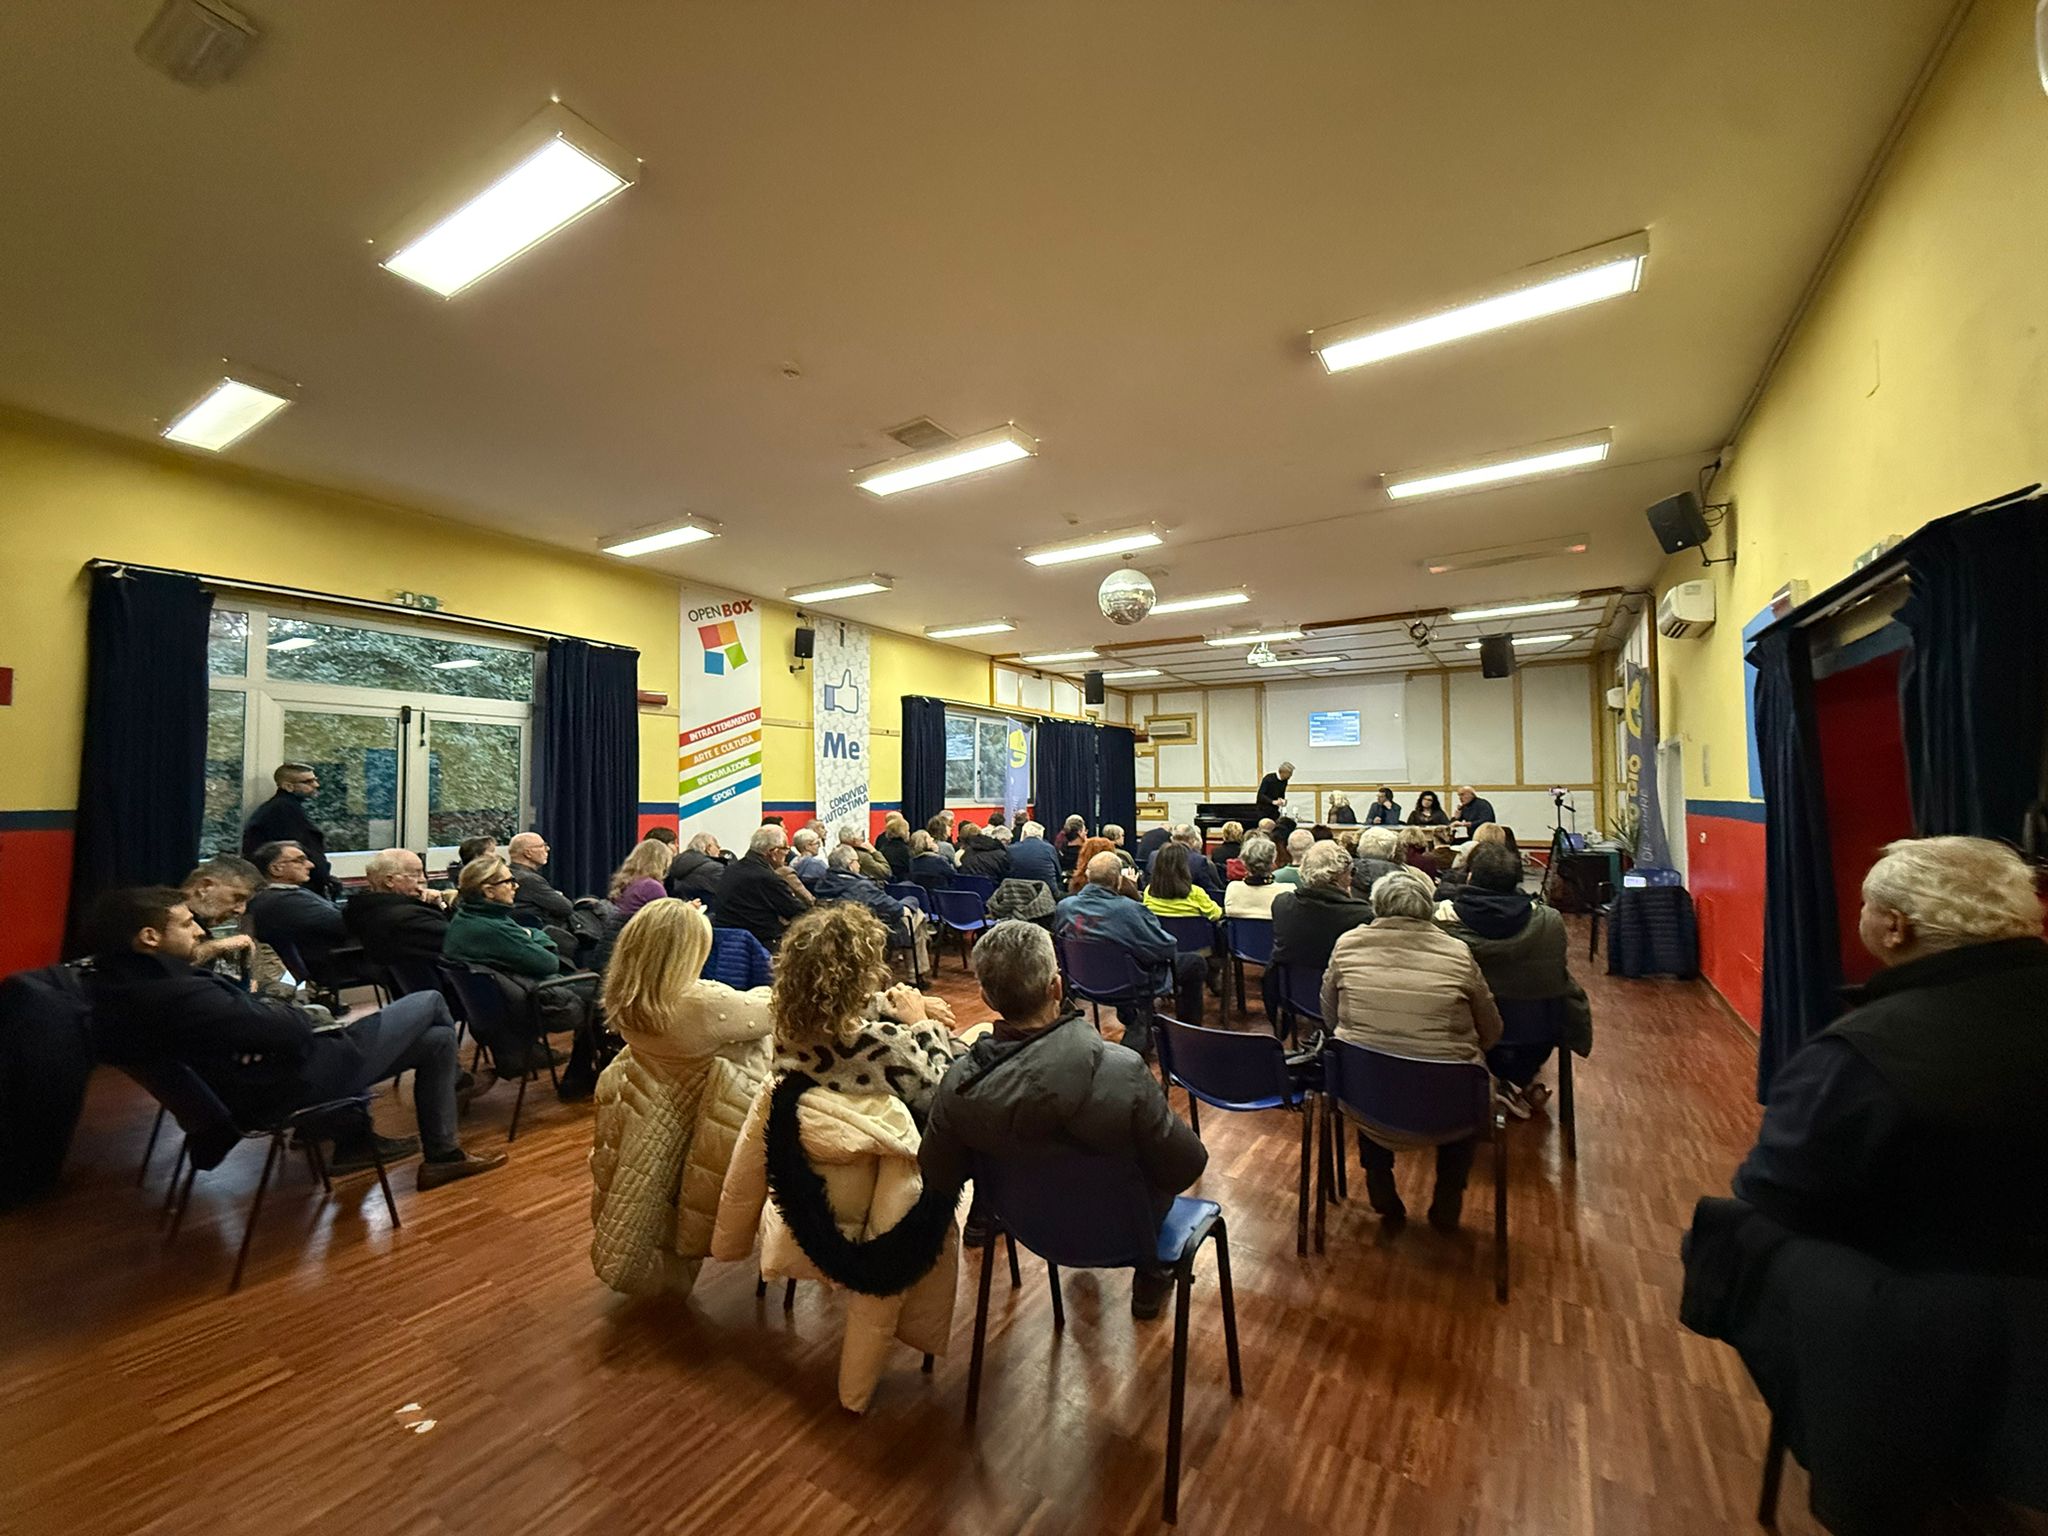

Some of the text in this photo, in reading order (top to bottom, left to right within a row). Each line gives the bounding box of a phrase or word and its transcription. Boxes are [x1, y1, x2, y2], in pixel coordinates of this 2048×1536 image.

[688, 599, 754, 622] OPEN BOX
[689, 711, 756, 741] INTRATTENIMENTO
[693, 749, 713, 764] ARTE
[720, 734, 754, 753] CULTURA
[823, 731, 860, 760] Me
[697, 758, 751, 785] INFORMAZIONE
[711, 786, 737, 803] SPORT
[829, 783, 868, 810] CONDIVIDI
